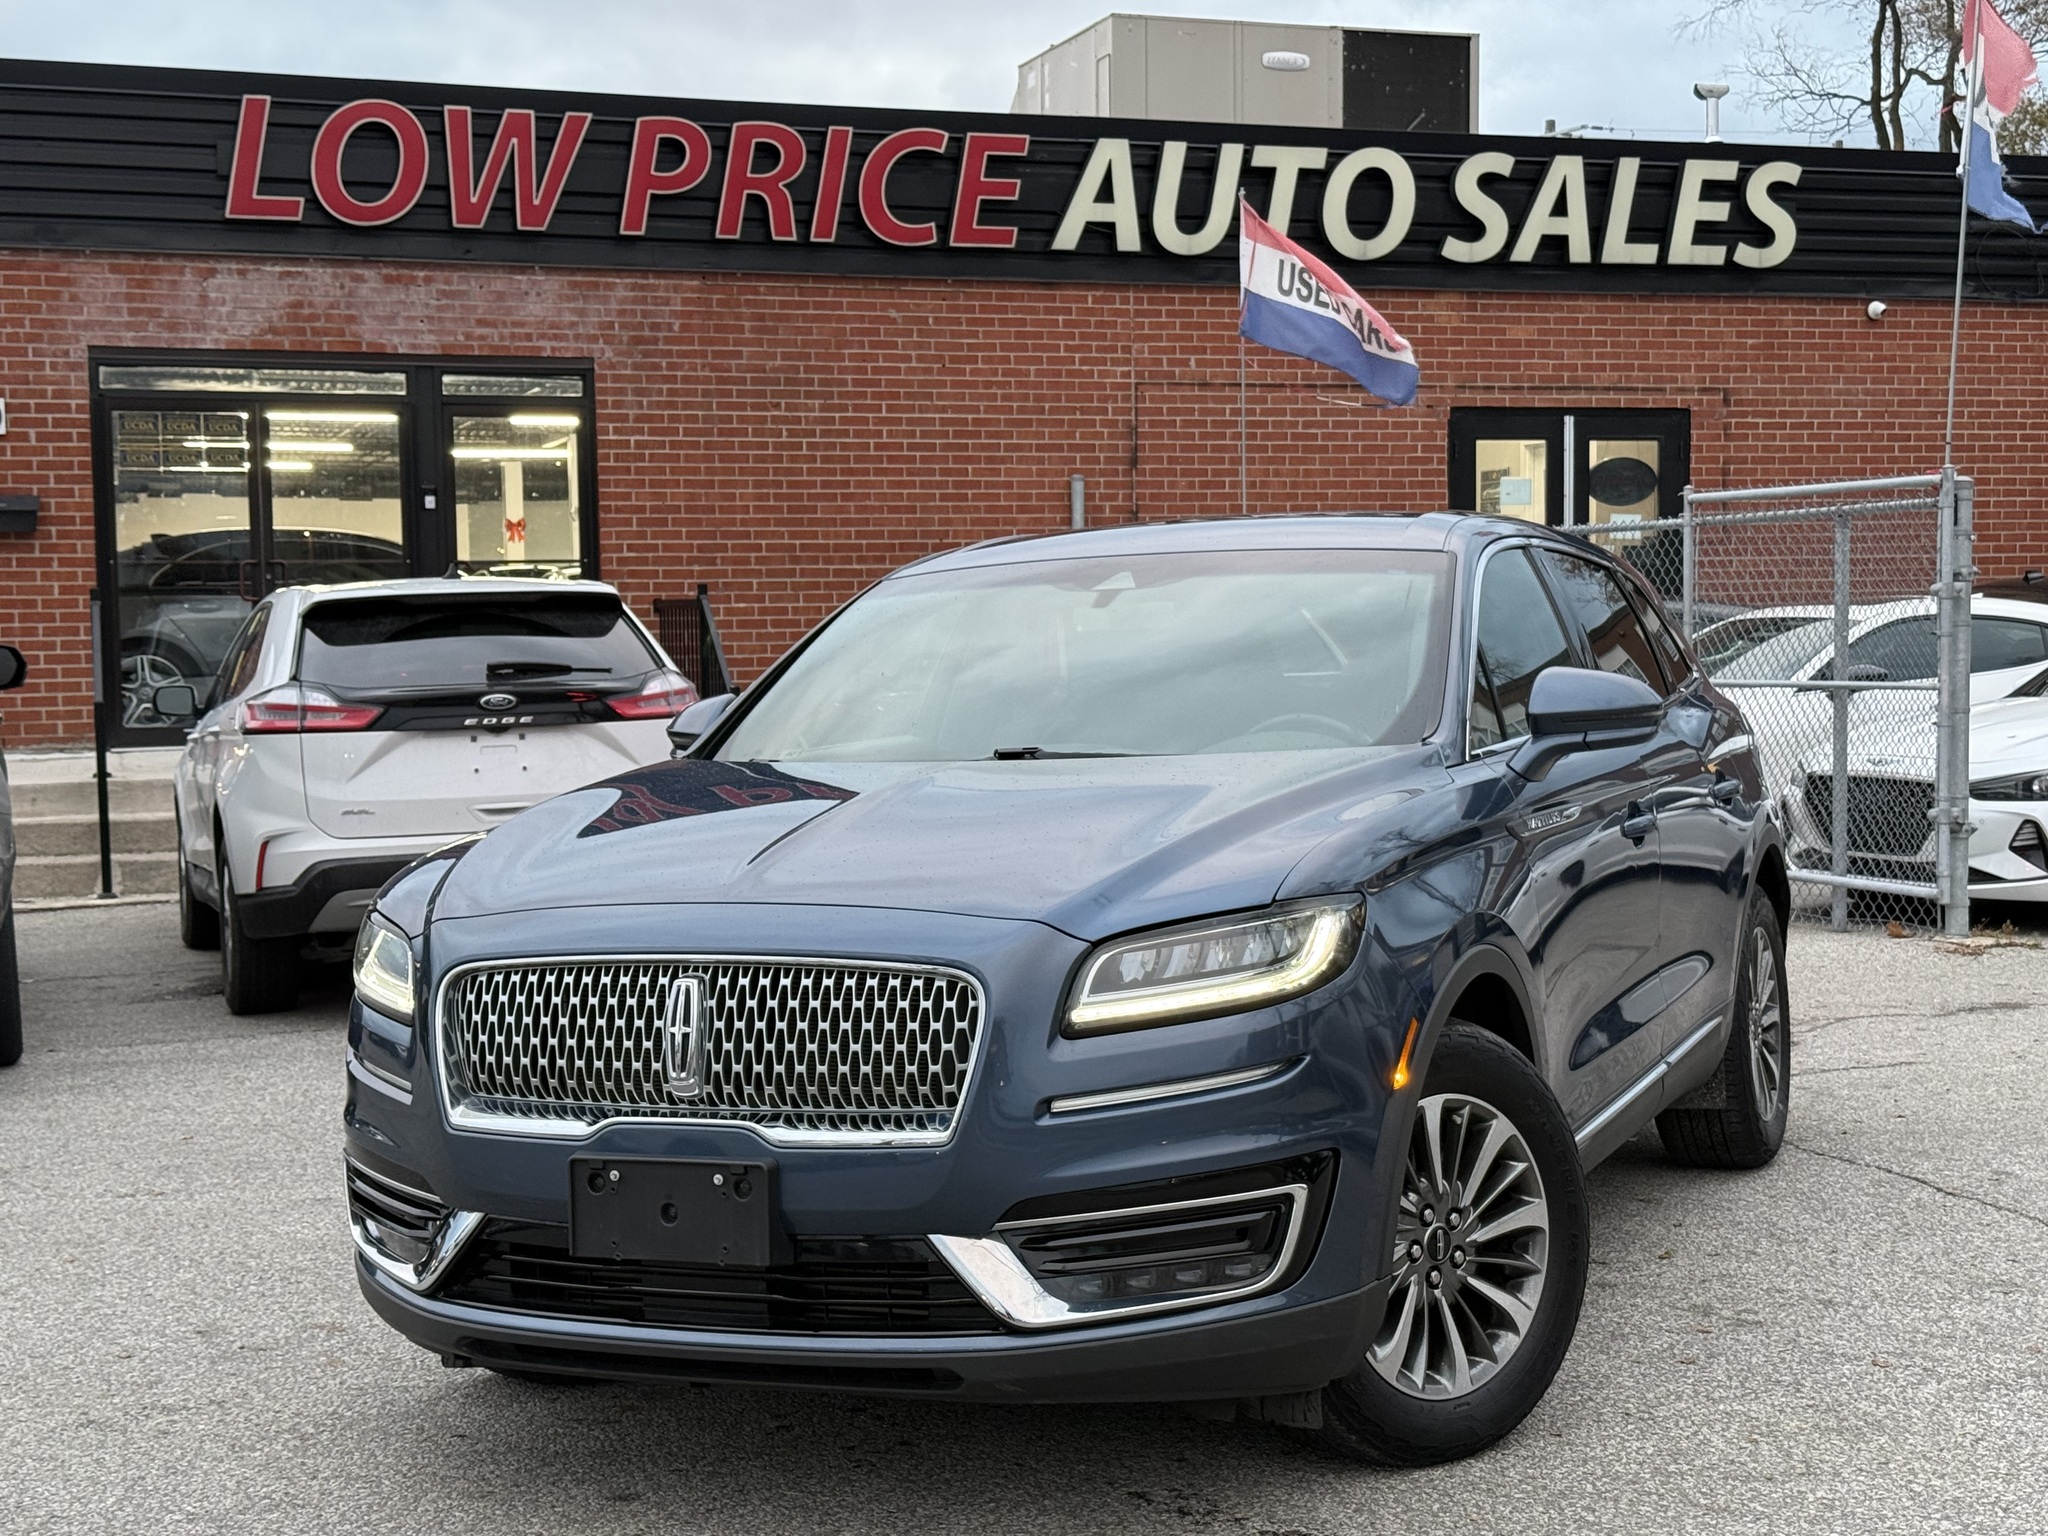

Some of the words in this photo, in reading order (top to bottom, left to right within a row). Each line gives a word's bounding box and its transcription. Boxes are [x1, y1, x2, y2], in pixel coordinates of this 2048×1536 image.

[224, 94, 593, 231] LOW
[619, 116, 1030, 248] PRICE
[1049, 137, 1418, 262] AUTO
[1440, 151, 1803, 269] SALES
[124, 421, 154, 432] UCDA
[166, 422, 197, 432] UCDA
[208, 423, 239, 433] UCDA
[463, 715, 535, 726] EDGE
